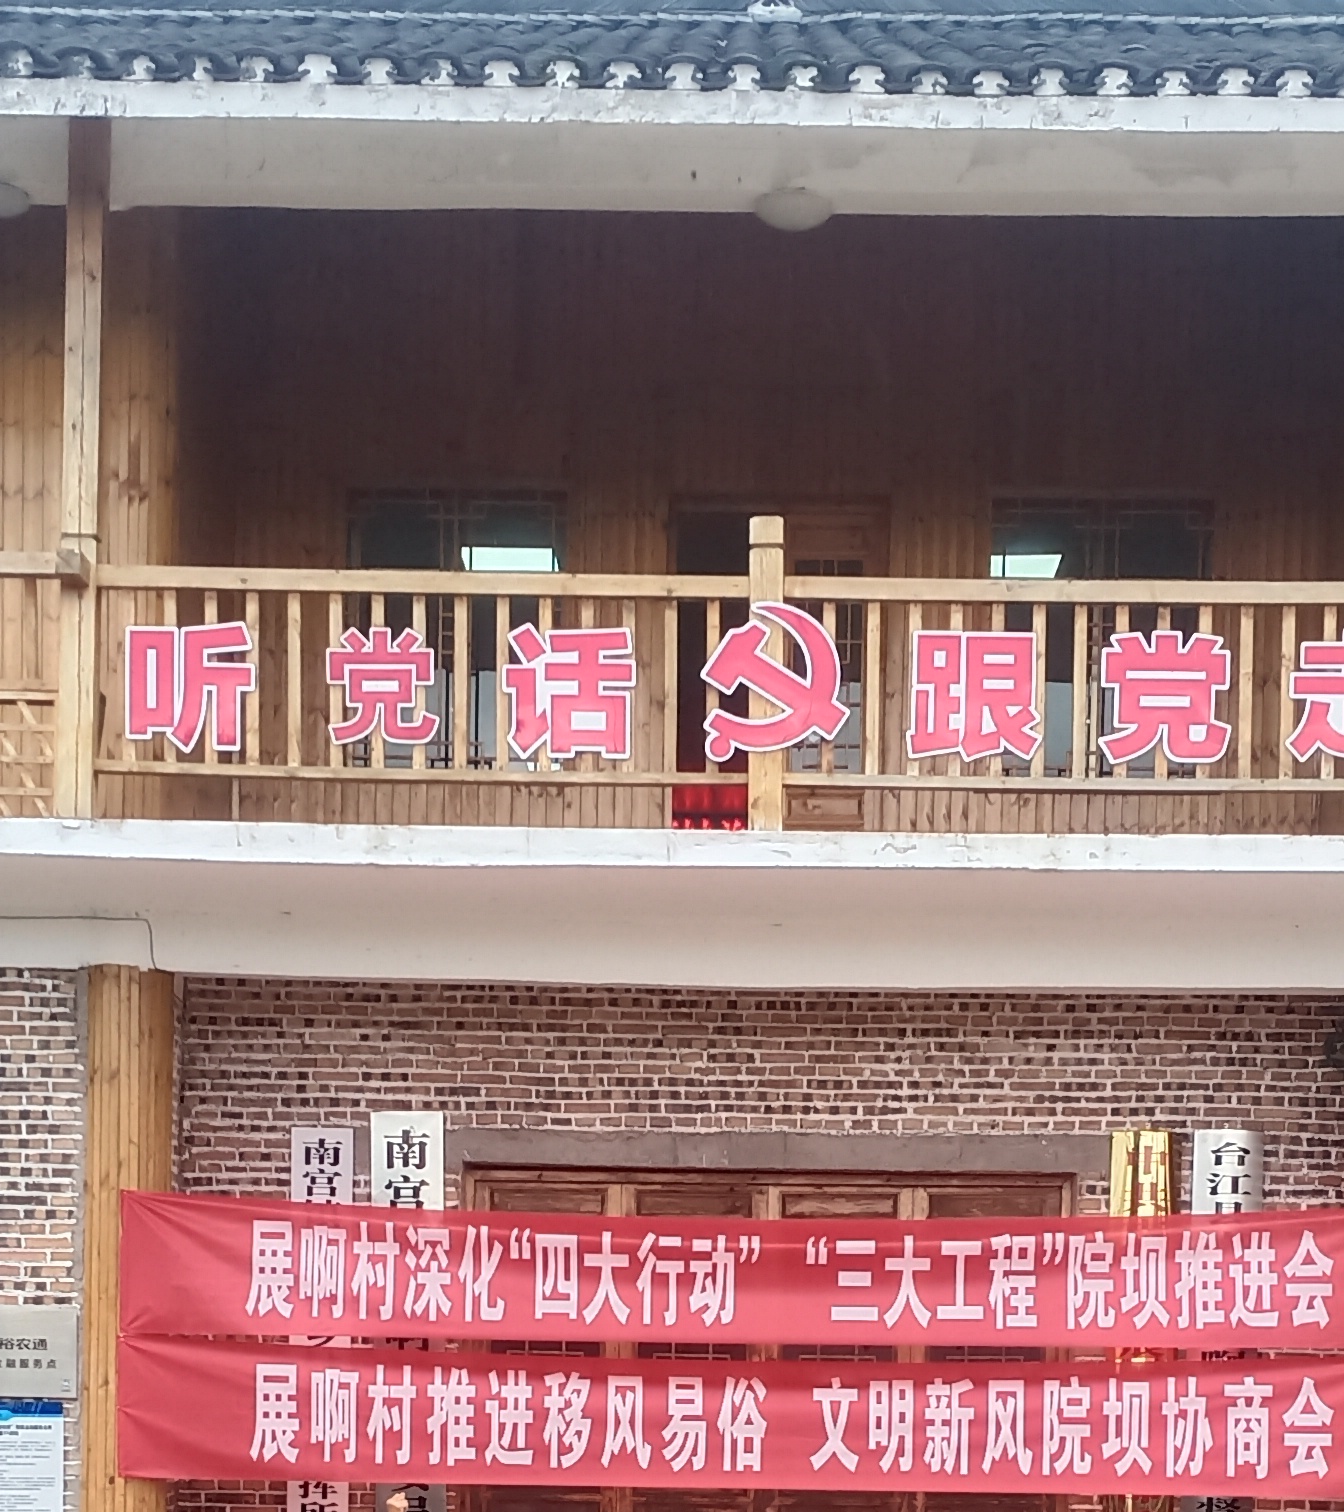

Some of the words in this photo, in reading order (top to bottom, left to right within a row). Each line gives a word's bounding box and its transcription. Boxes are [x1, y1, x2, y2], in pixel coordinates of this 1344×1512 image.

[123, 620, 637, 760] 听党话
[302, 1138, 343, 1204] 南宫
[250, 1363, 768, 1472] 展啊村推进移风易俗
[810, 1376, 1334, 1479] 文明新风院坝协商会
